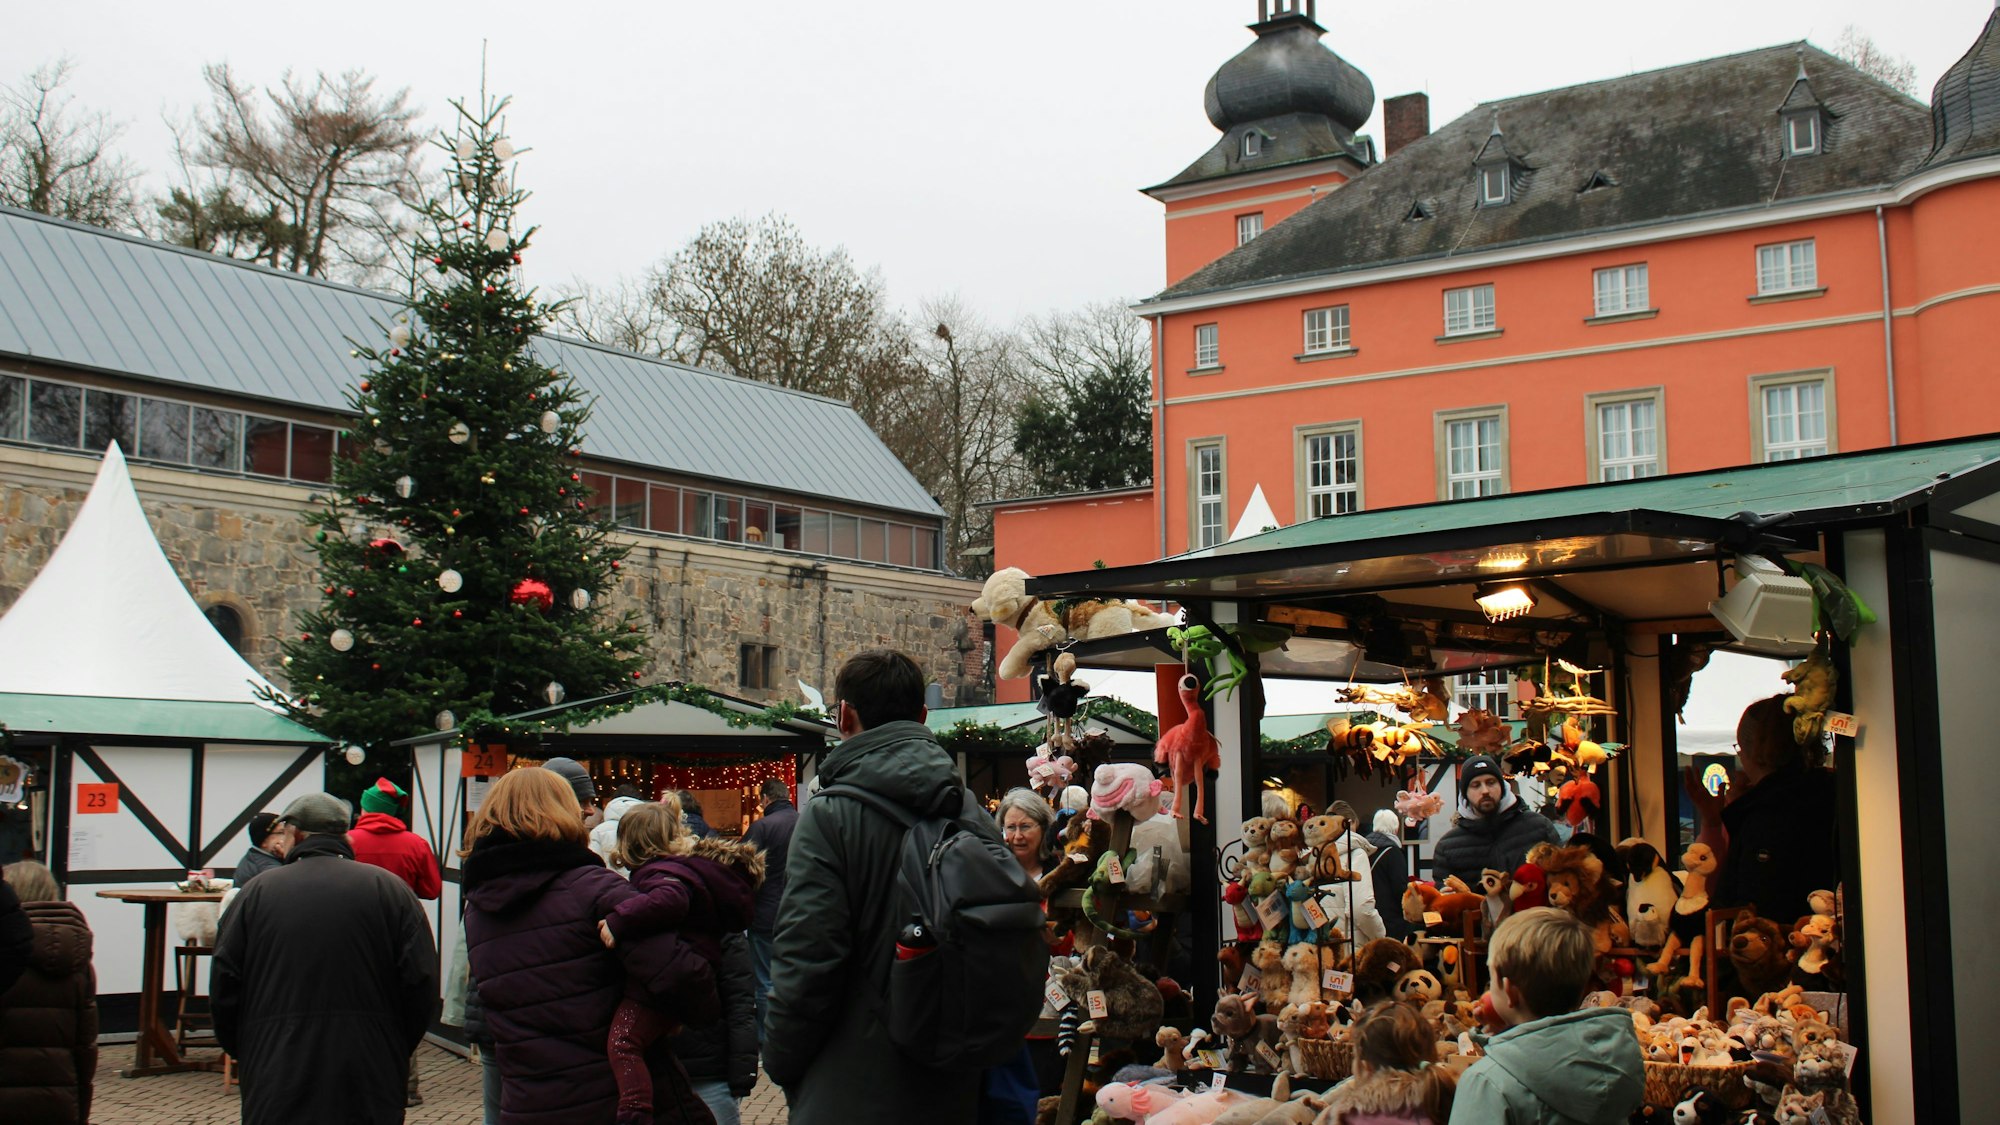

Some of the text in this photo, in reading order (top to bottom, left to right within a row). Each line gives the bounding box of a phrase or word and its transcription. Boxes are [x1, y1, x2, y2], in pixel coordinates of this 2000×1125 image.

[474, 754, 493, 769] 24
[87, 793, 107, 807] 23
[913, 925, 922, 937] 6
